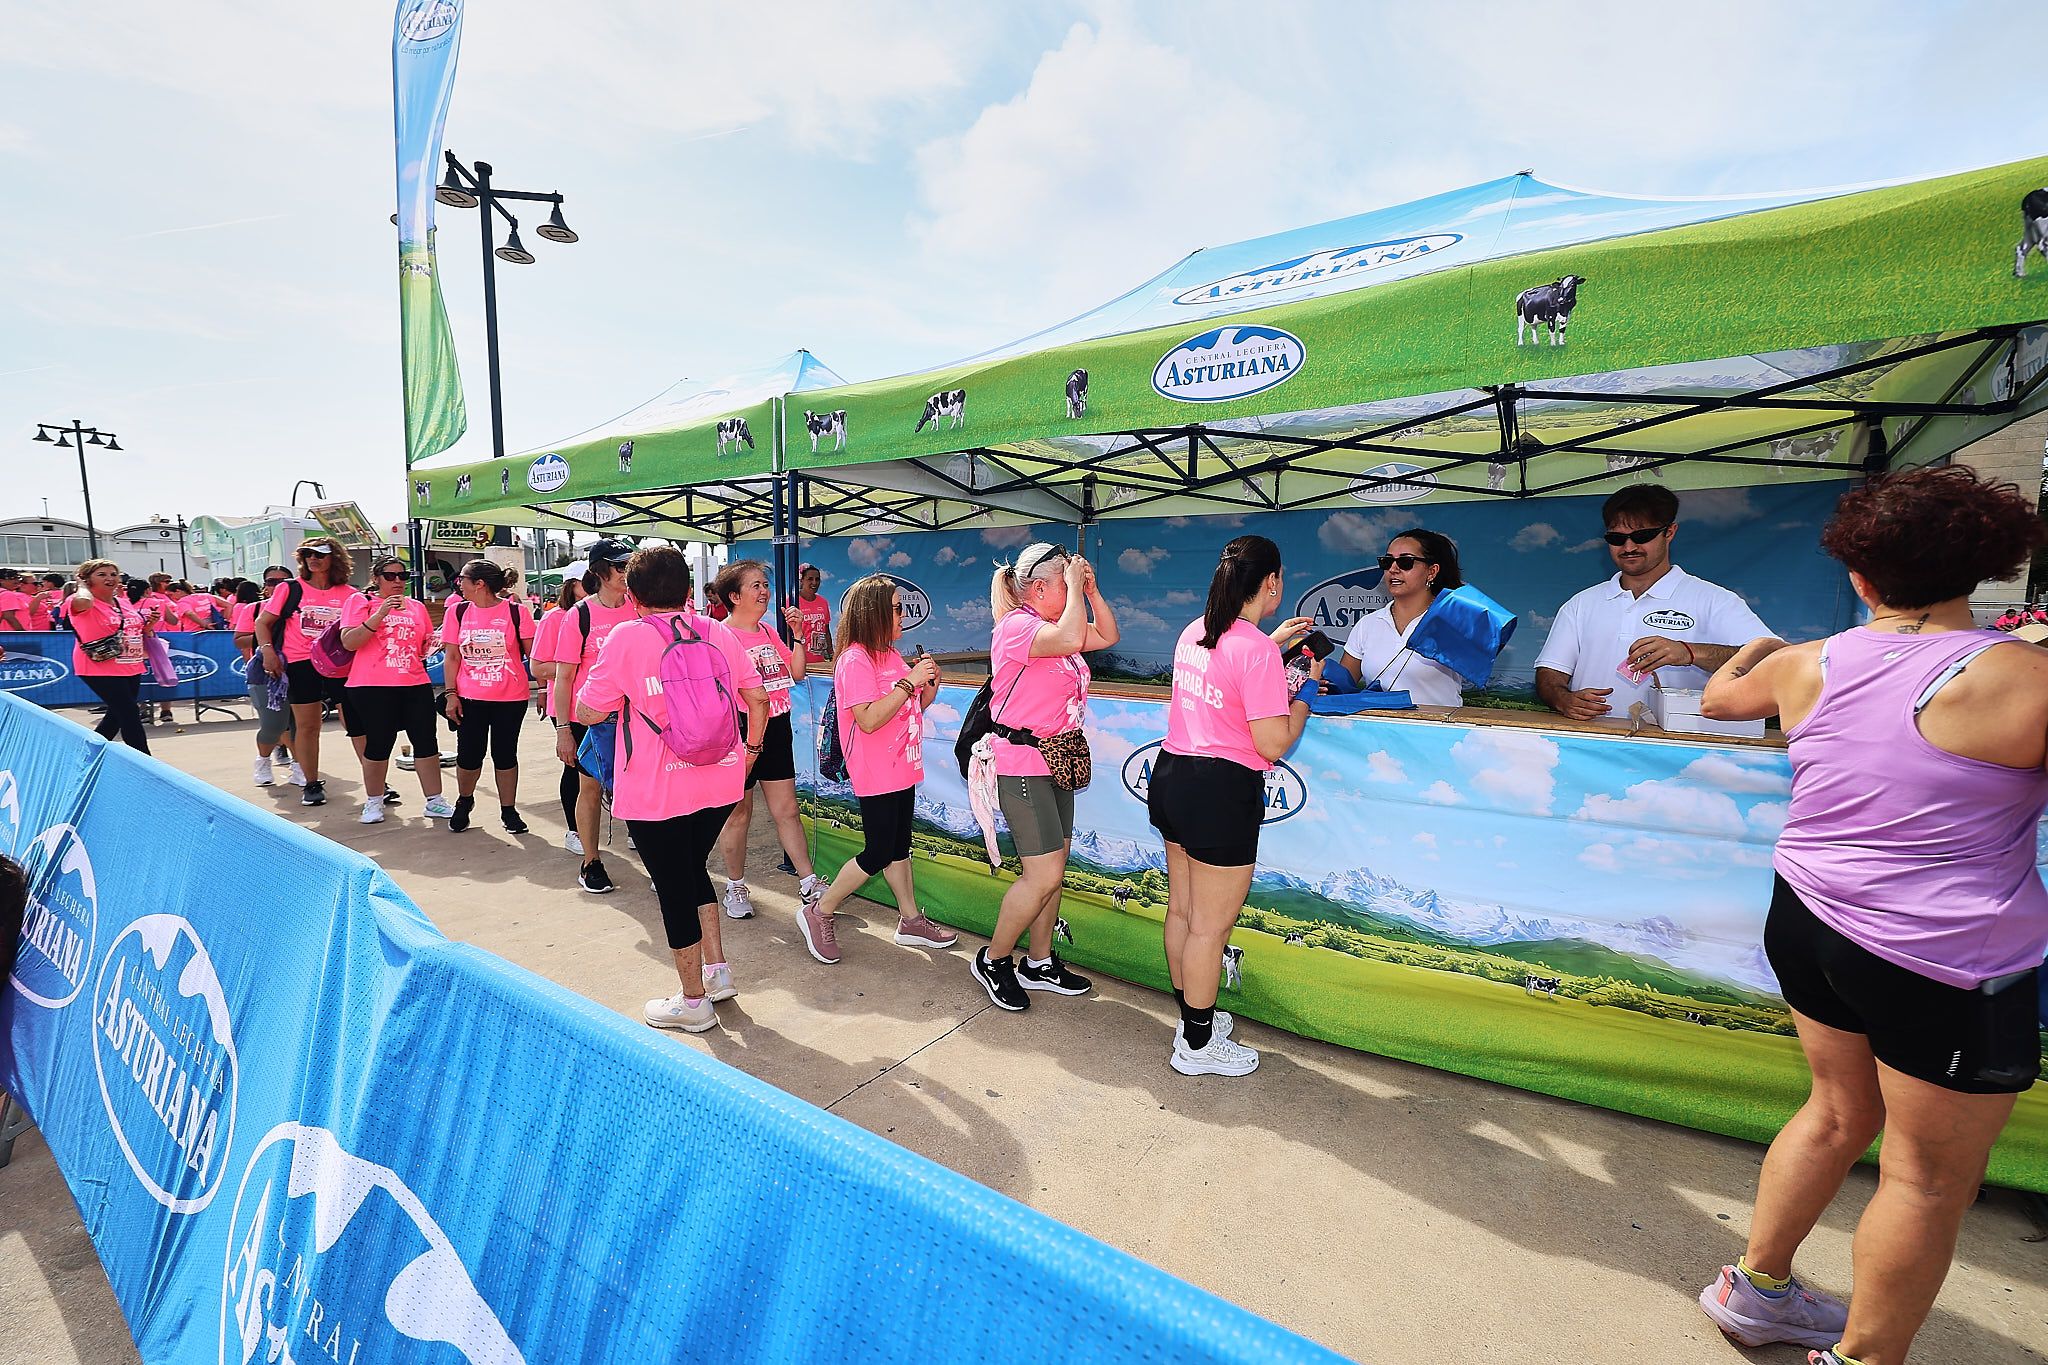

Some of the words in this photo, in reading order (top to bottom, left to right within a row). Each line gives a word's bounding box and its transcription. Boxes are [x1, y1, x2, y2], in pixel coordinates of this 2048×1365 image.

[1185, 351, 1232, 365] CENTRAL
[1236, 342, 1288, 357] LECHERA
[1162, 353, 1291, 389] ASTURIANA
[530, 469, 566, 485] ASTURIANA
[437, 529, 478, 538] GOZADA
[1338, 595, 1390, 604] CENTRA
[1646, 616, 1691, 627] ASTURIANA
[386, 656, 411, 669] MUJER
[1176, 643, 1211, 673] SOMOS
[54, 887, 90, 929] LECHERA
[130, 964, 171, 1028] CENTRAL
[171, 1018, 226, 1095] LECHERA
[96, 955, 219, 1190] ASTURIANA
